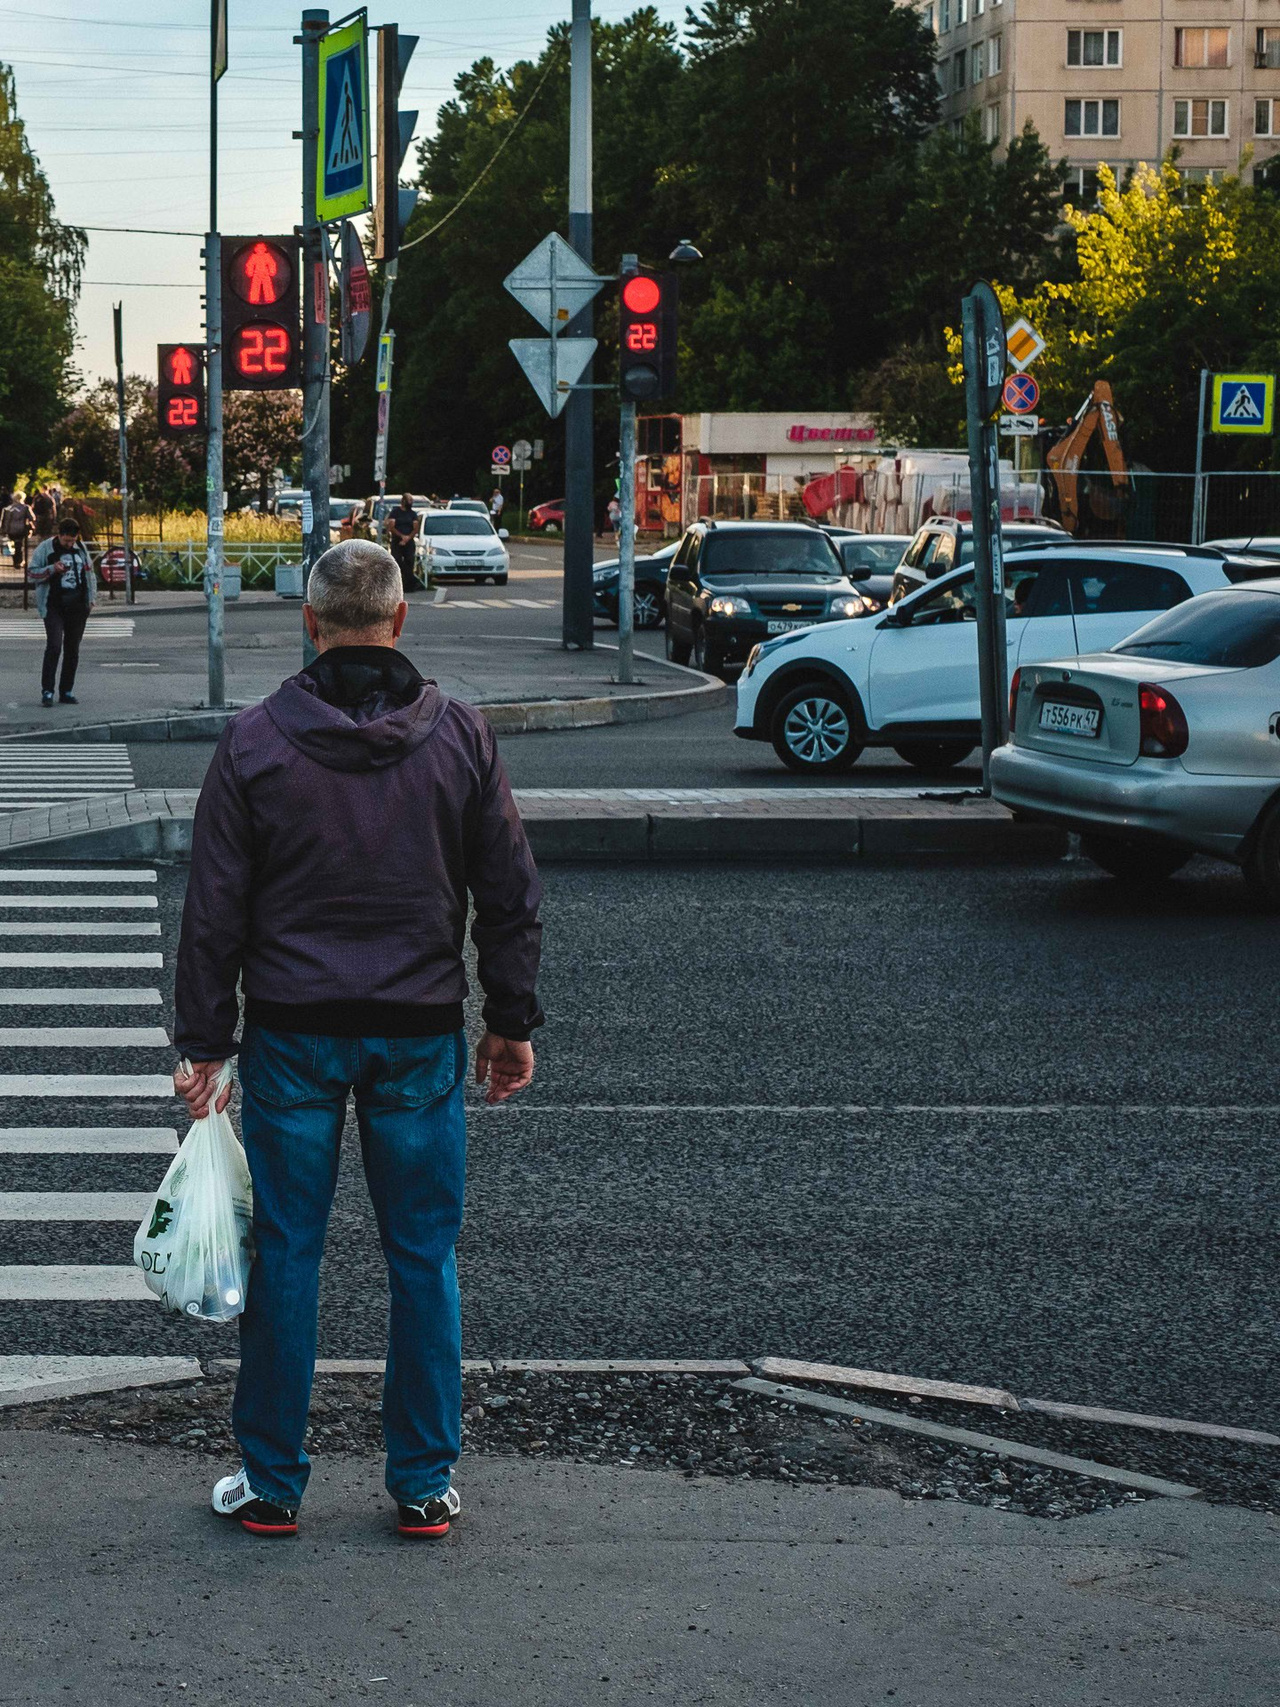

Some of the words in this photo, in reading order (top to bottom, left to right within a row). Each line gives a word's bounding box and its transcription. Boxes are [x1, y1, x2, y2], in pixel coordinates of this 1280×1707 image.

[239, 328, 290, 374] 22
[627, 322, 657, 351] 22
[168, 397, 199, 427] 22
[1084, 710, 1096, 725] 47
[221, 1481, 246, 1507] PUMA
